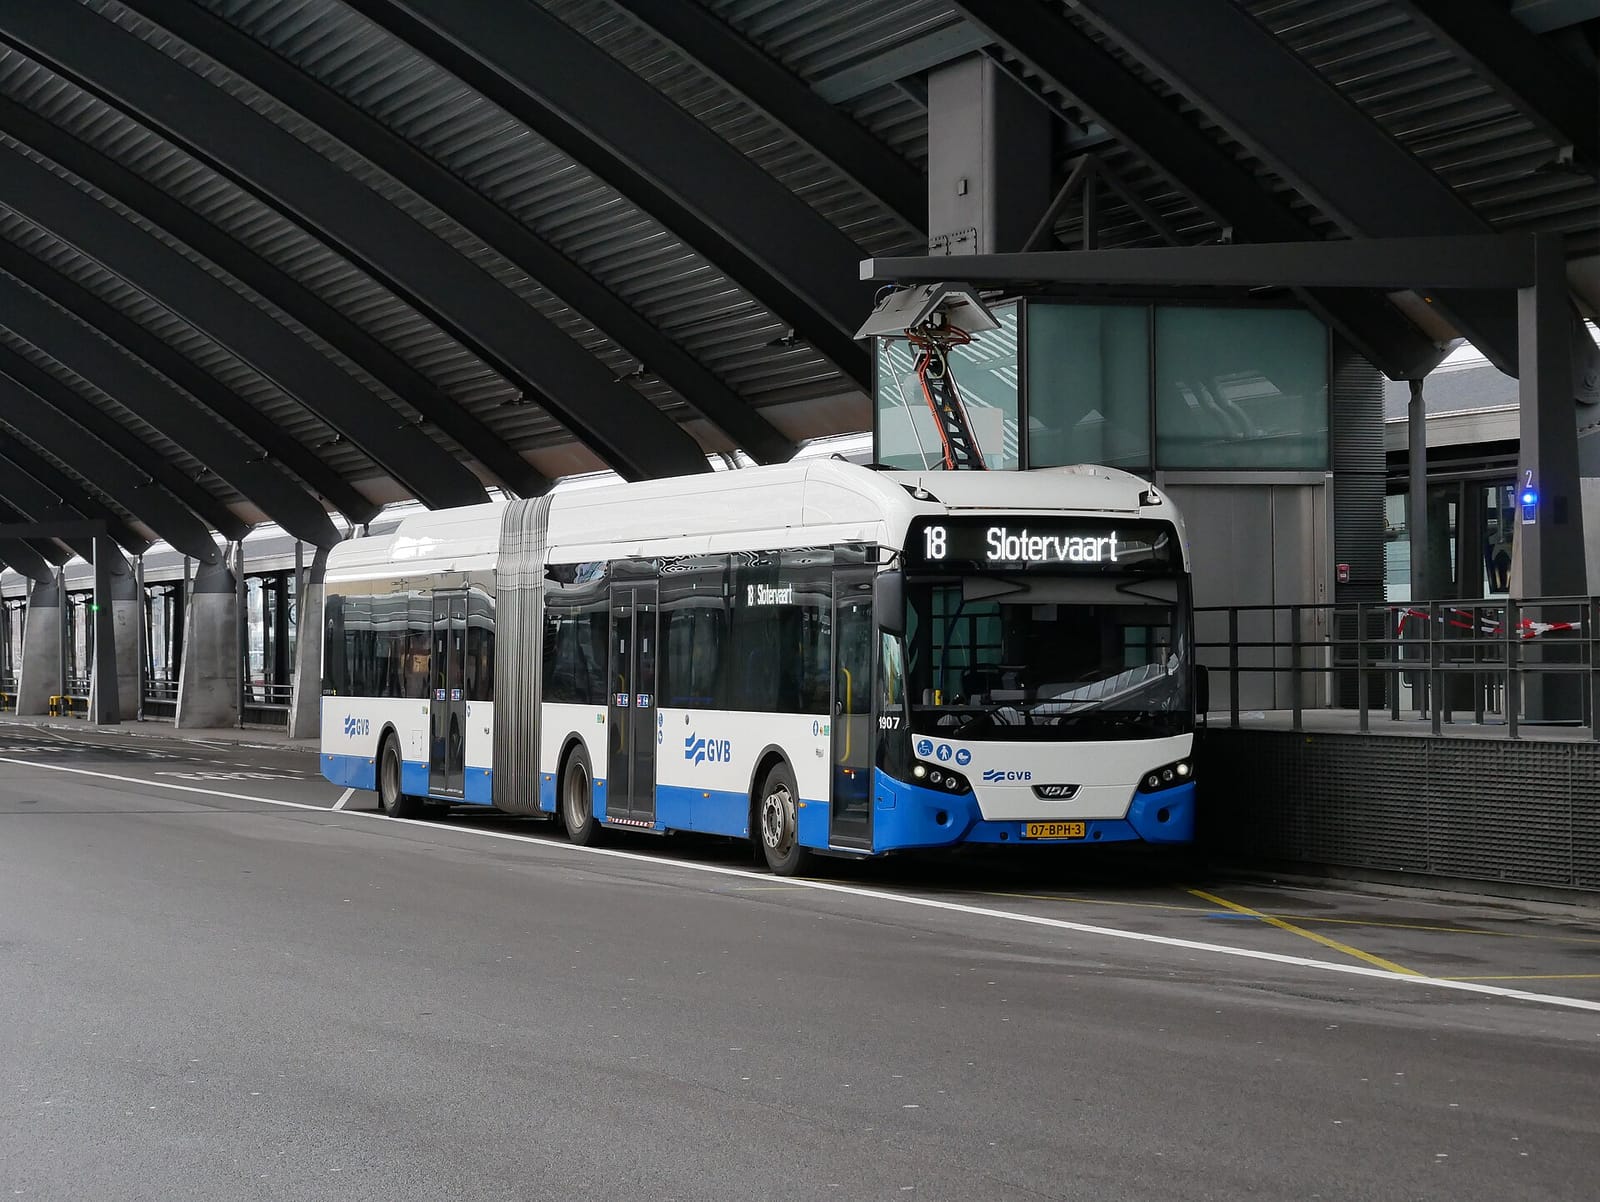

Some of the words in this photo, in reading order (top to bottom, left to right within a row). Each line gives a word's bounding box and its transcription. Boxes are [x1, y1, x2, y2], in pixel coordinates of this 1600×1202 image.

[1525, 470, 1533, 488] 2
[923, 526, 947, 560] 18
[986, 527, 1118, 562] Slotervaart
[757, 583, 792, 605] Slotervaart
[356, 718, 370, 736] GVB
[878, 716, 900, 730] 1907
[707, 738, 731, 763] GVB
[1006, 771, 1032, 781] GVB
[1040, 786, 1072, 796] VDL
[1030, 824, 1081, 836] 07-BPH-3
